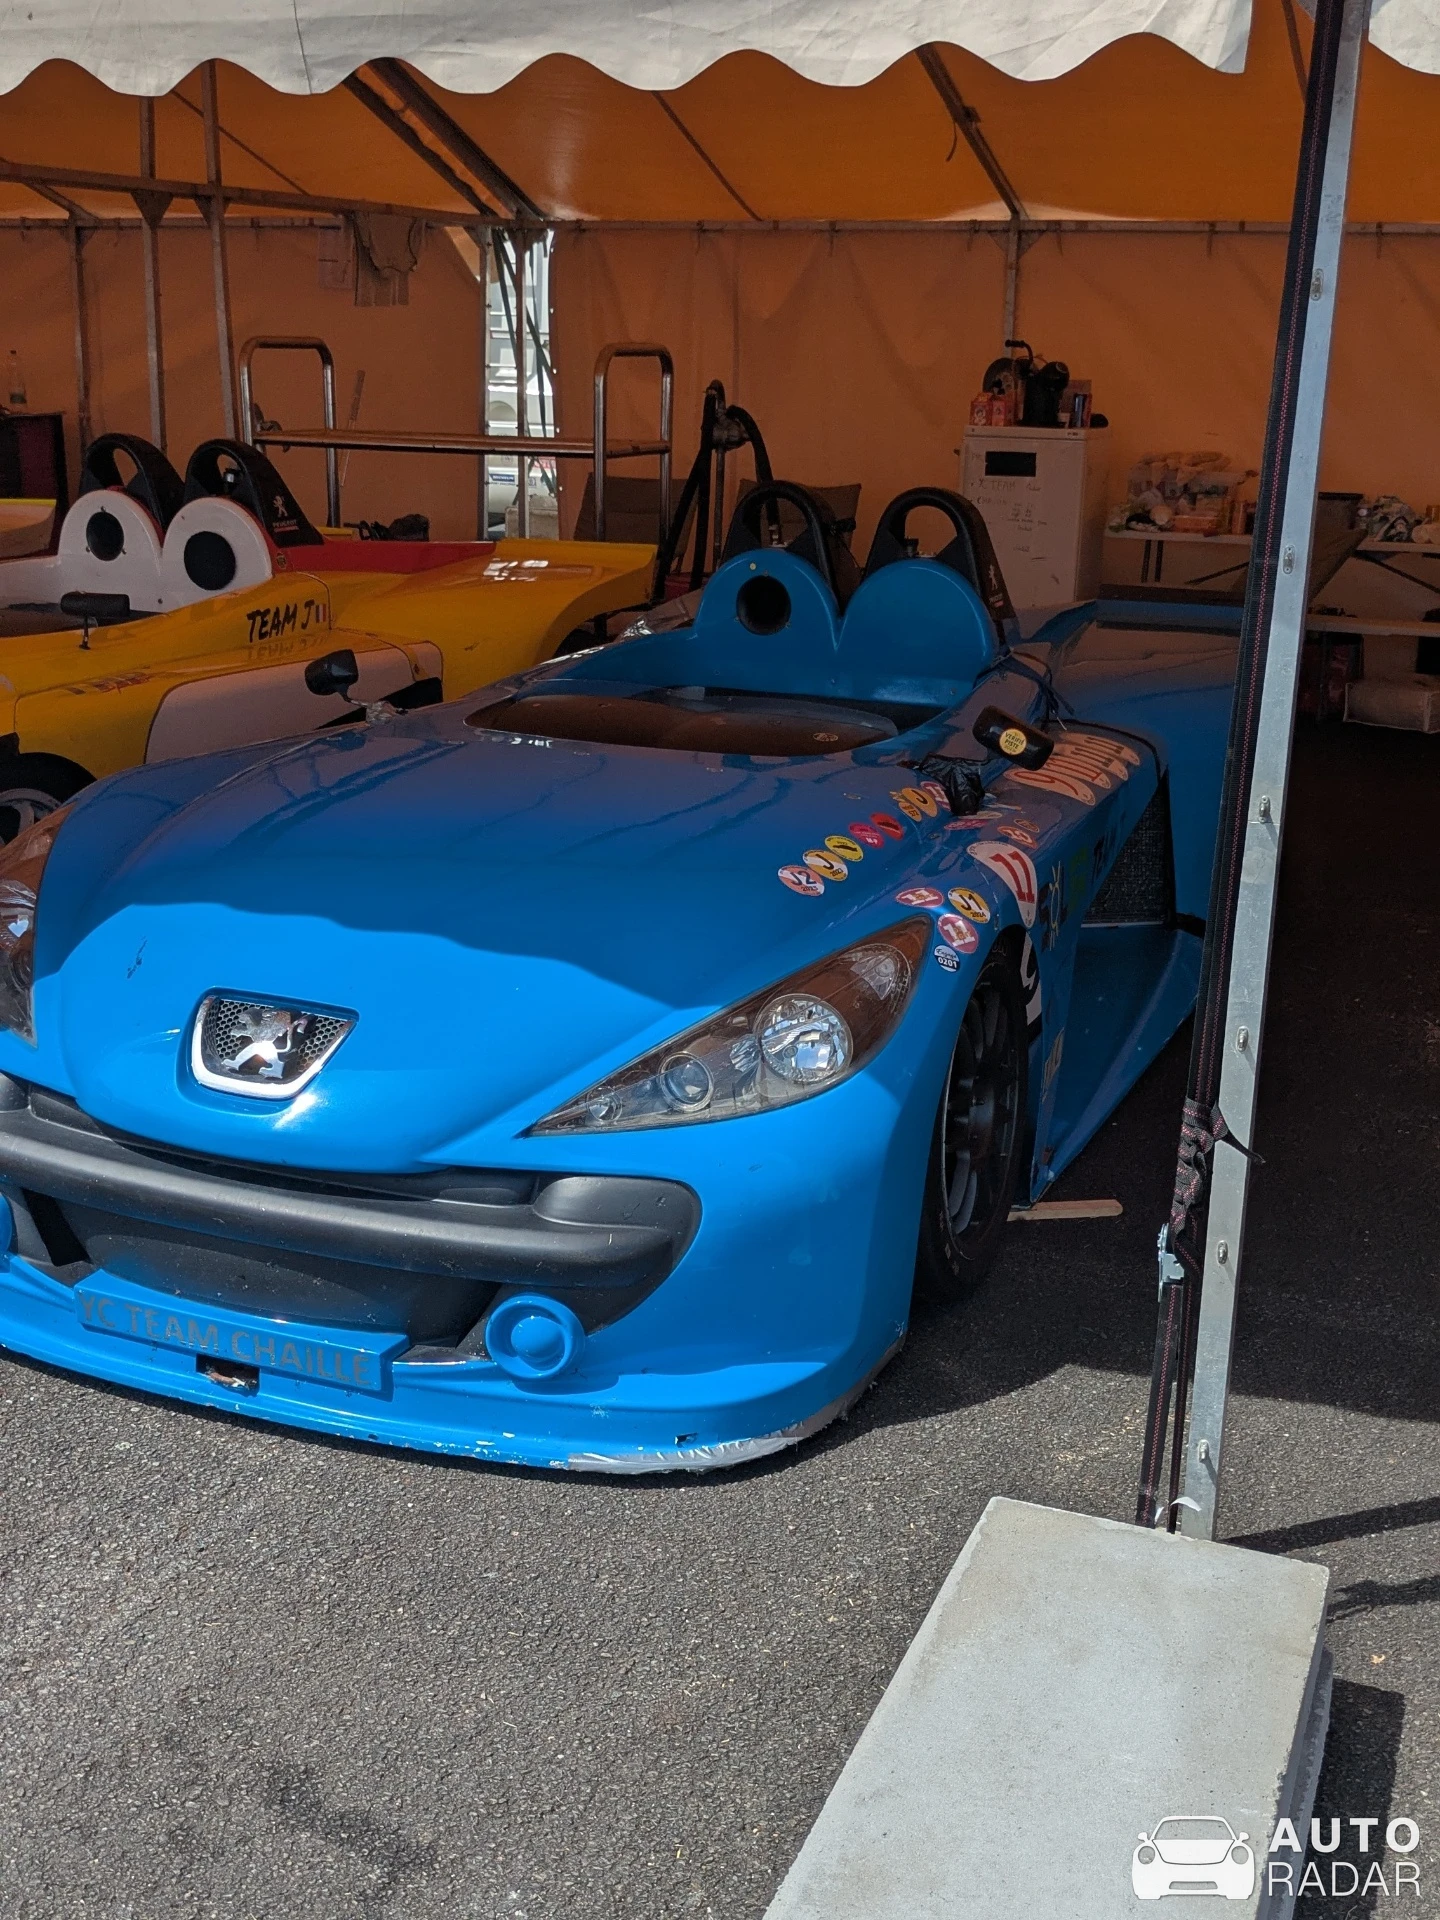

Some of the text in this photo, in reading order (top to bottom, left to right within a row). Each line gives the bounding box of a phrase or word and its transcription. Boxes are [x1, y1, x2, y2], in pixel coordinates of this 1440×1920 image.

[246, 603, 298, 643] TEAM
[1004, 739, 1020, 749] PISTE
[790, 870, 817, 886] J2
[958, 893, 983, 912] J1
[943, 919, 976, 947] 11
[937, 956, 958, 969] 0201
[124, 1304, 220, 1351] TEAM
[231, 1330, 371, 1386] CHAILLE
